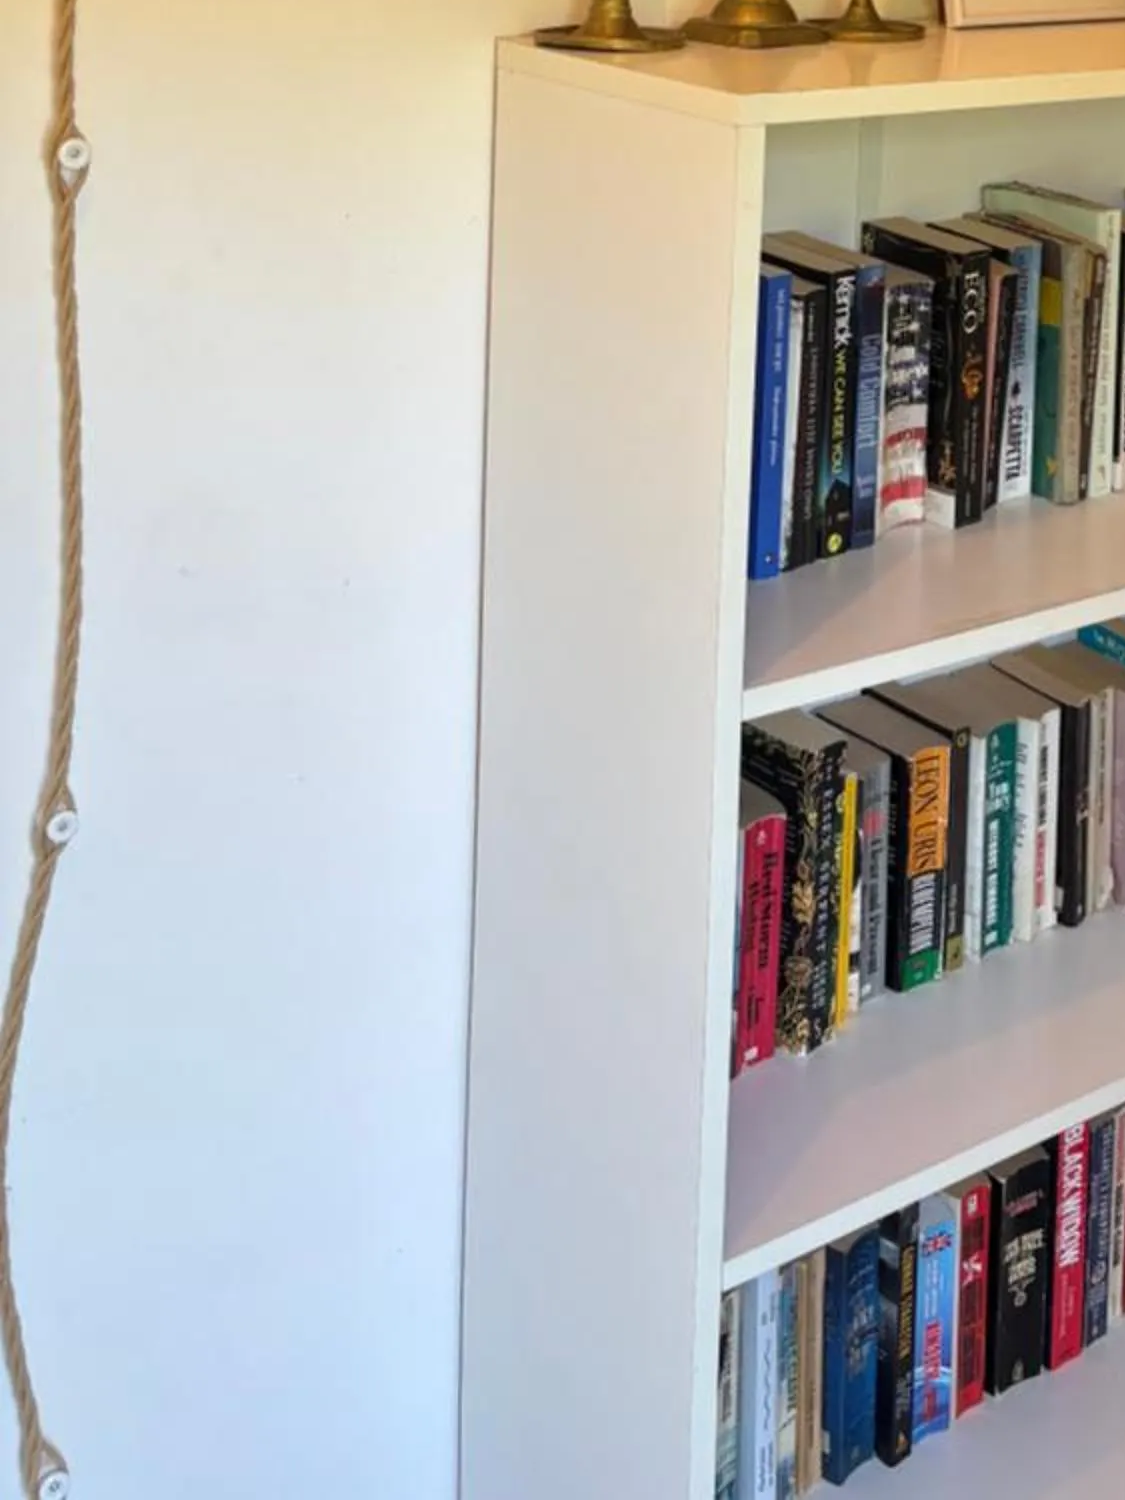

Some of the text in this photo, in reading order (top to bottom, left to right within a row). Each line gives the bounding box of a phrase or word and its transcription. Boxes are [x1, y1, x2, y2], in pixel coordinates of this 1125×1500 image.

[833, 275, 855, 348] Kernick
[964, 272, 980, 335] ECO
[860, 333, 882, 373] Cold
[831, 350, 846, 475] WE CAN SEE YOU
[856, 376, 881, 450] Comfort
[1005, 405, 1024, 483] SCARPETTA
[914, 755, 940, 870] LEON URIS
[1063, 1122, 1085, 1196] BLACK
[1058, 1197, 1081, 1269] WIDOW
